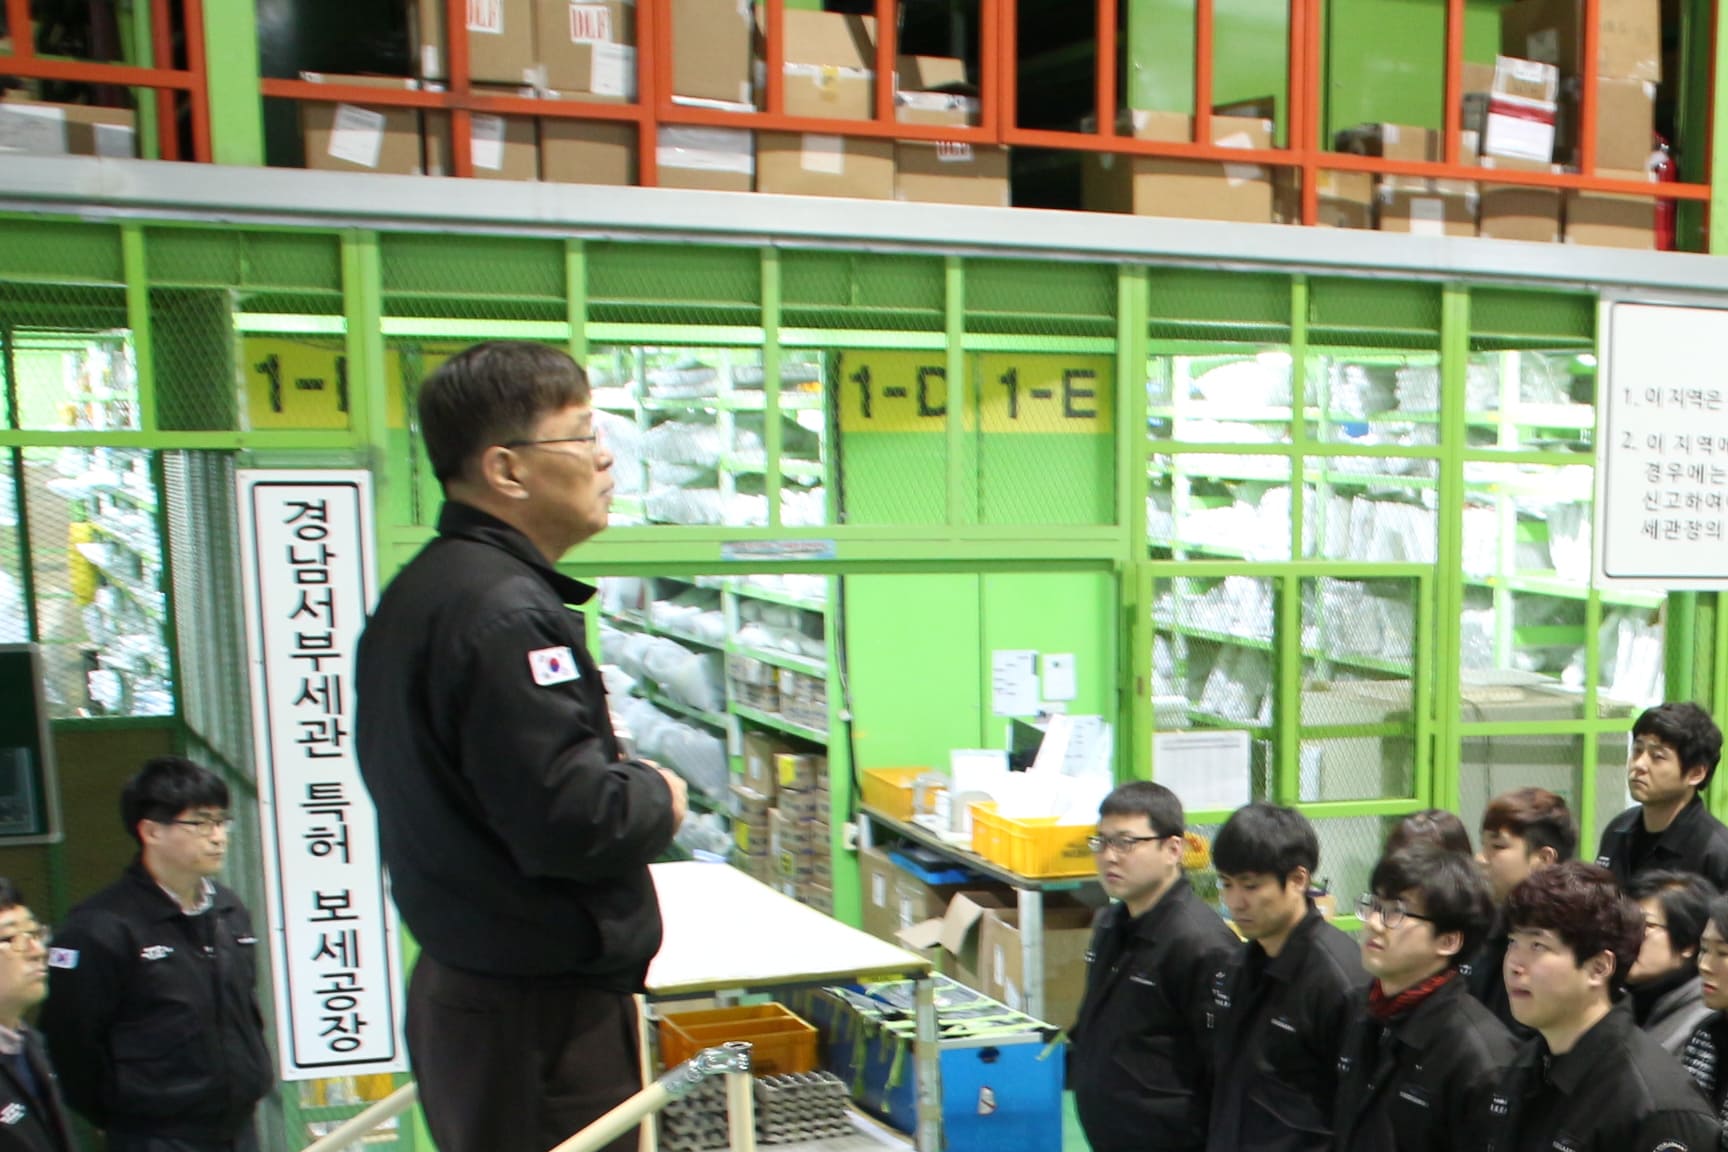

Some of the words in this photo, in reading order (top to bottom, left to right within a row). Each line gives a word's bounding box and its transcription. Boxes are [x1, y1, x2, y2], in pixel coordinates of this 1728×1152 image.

[998, 367, 1096, 419] 1-E
[1623, 387, 1640, 408] 1.
[1645, 386, 1662, 408] 이
[1668, 388, 1720, 411] 지역은
[1621, 431, 1638, 450] 2.
[1647, 432, 1662, 453] 이
[1646, 462, 1726, 485] 경우에는
[1641, 519, 1721, 541] 세관장의
[283, 499, 347, 758] 경남서부세관
[300, 782, 351, 864] 특허
[308, 889, 368, 1053] 보세공장
